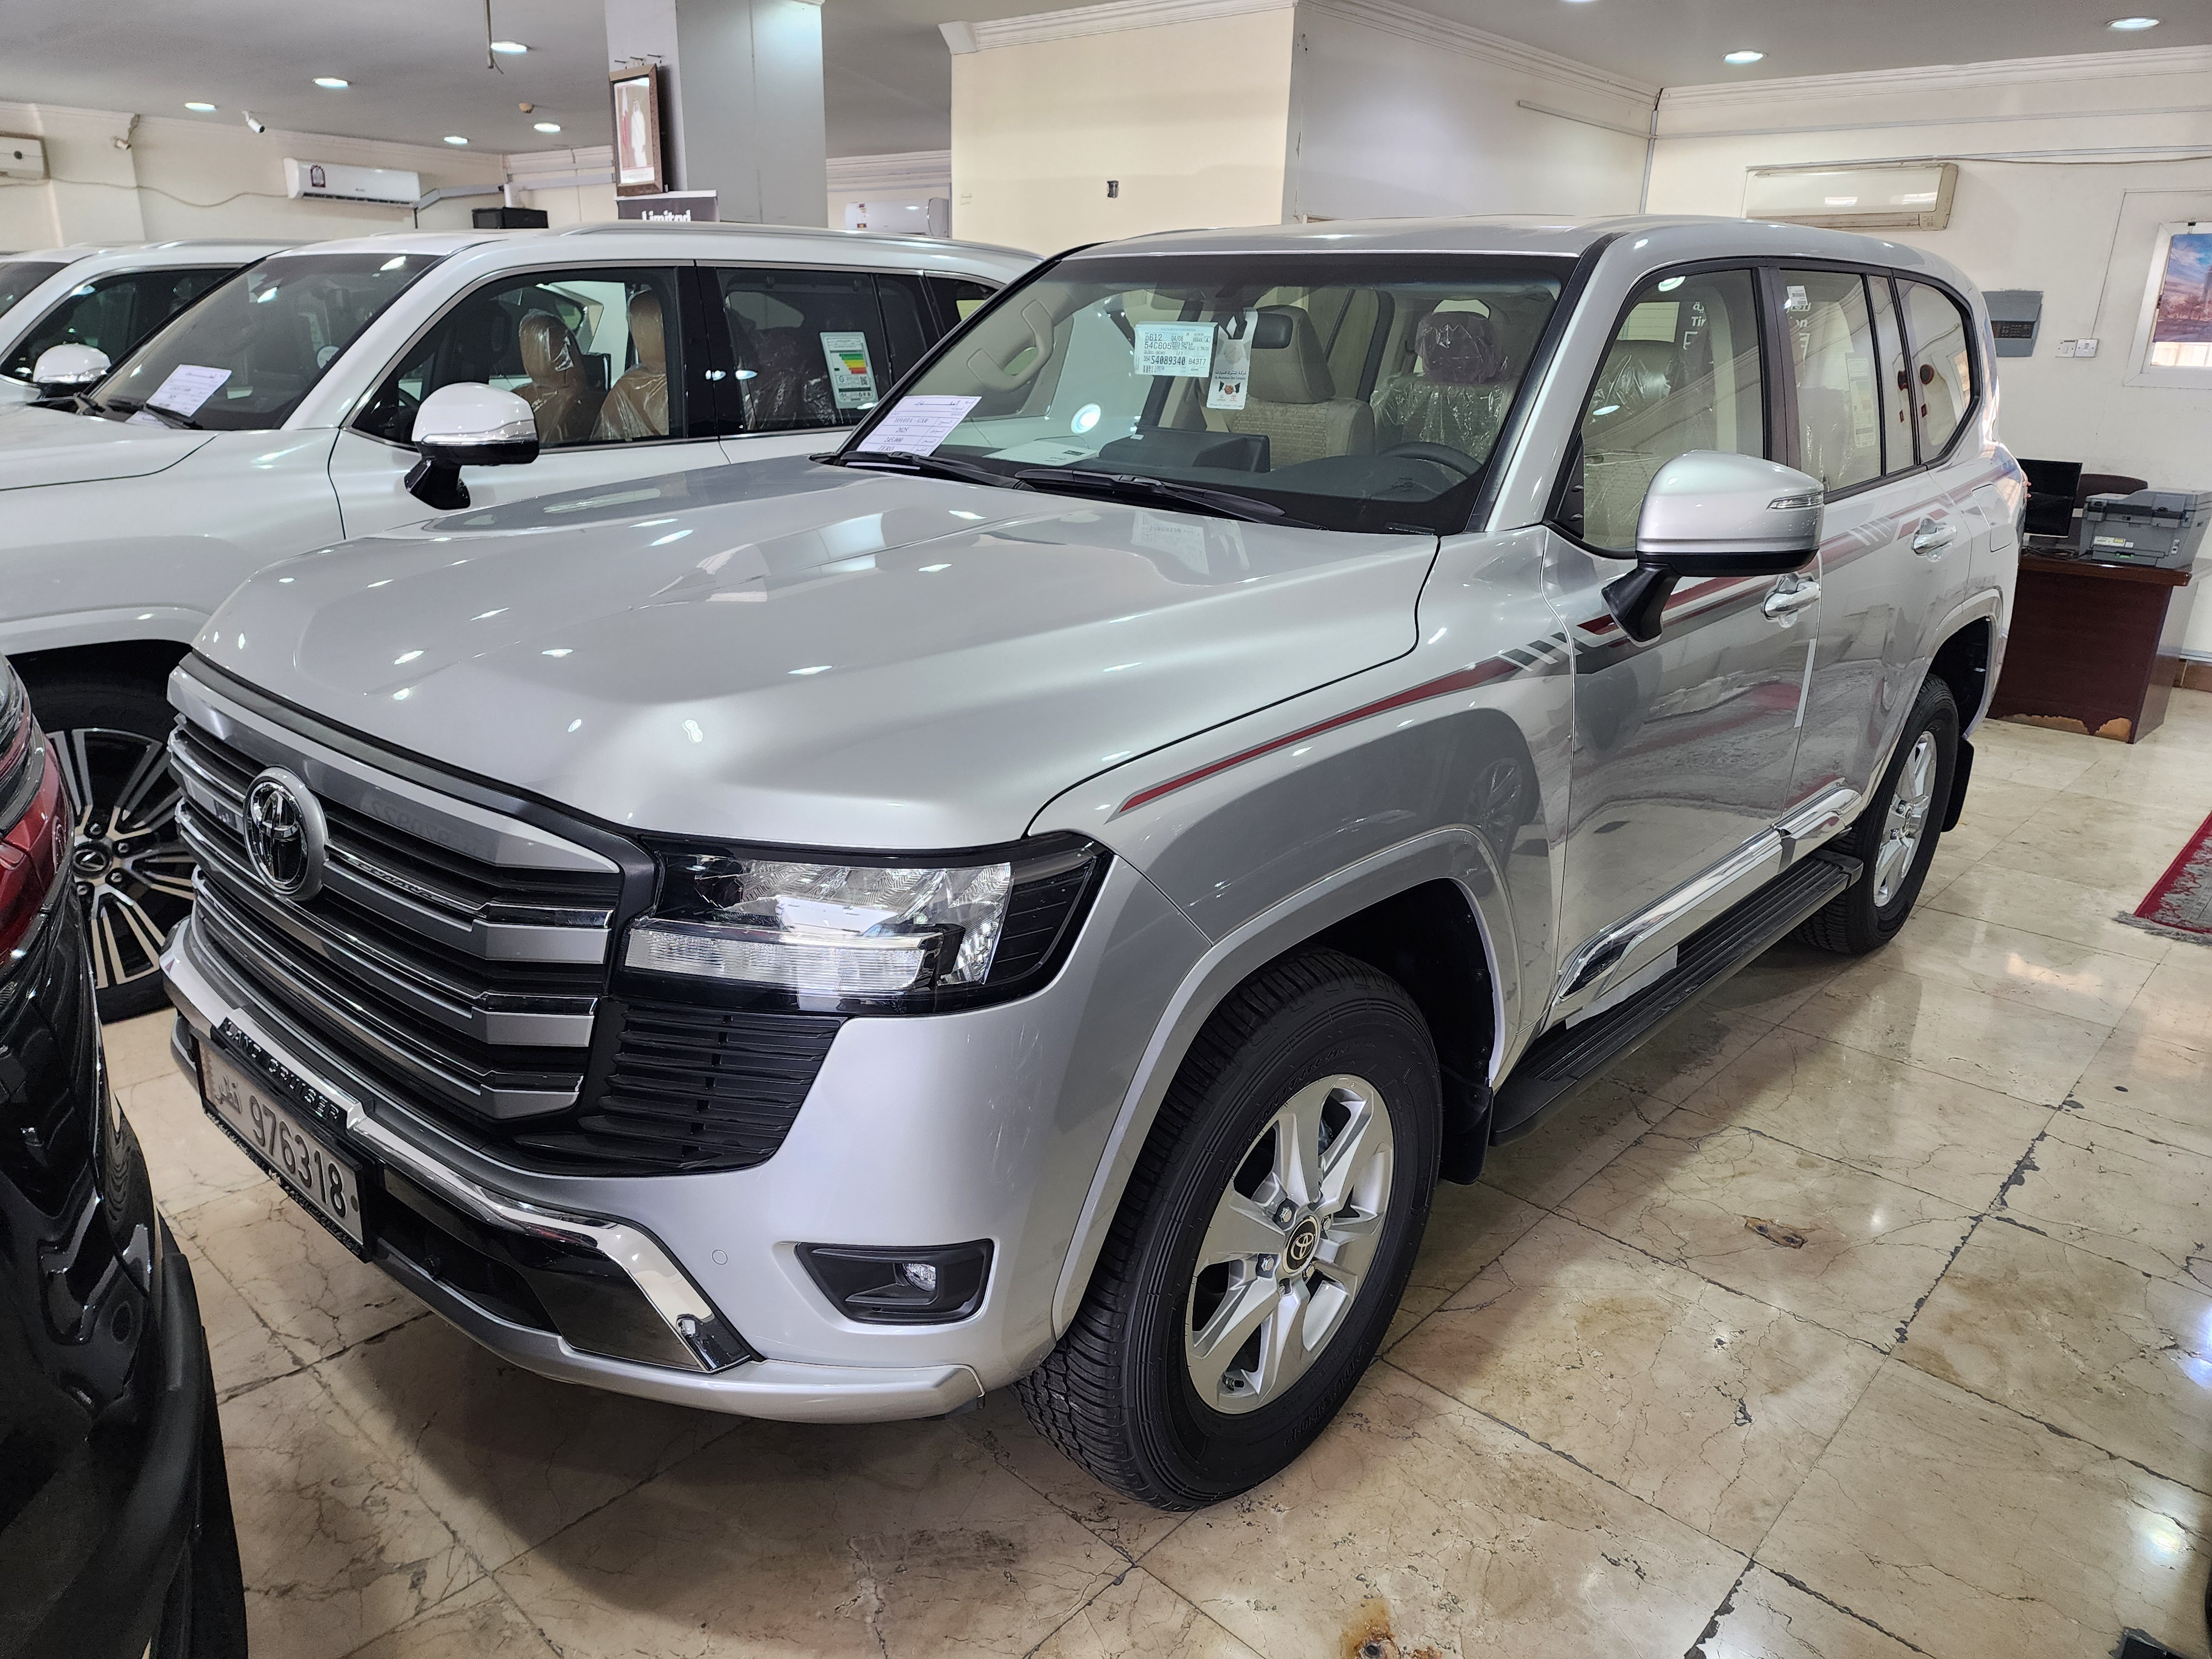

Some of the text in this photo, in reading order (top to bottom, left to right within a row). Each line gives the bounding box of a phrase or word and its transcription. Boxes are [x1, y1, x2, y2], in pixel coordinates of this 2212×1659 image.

[1151, 356, 1186, 366] S4089340
[268, 1058, 341, 1120] CRUISER
[249, 1094, 347, 1218] 976318
